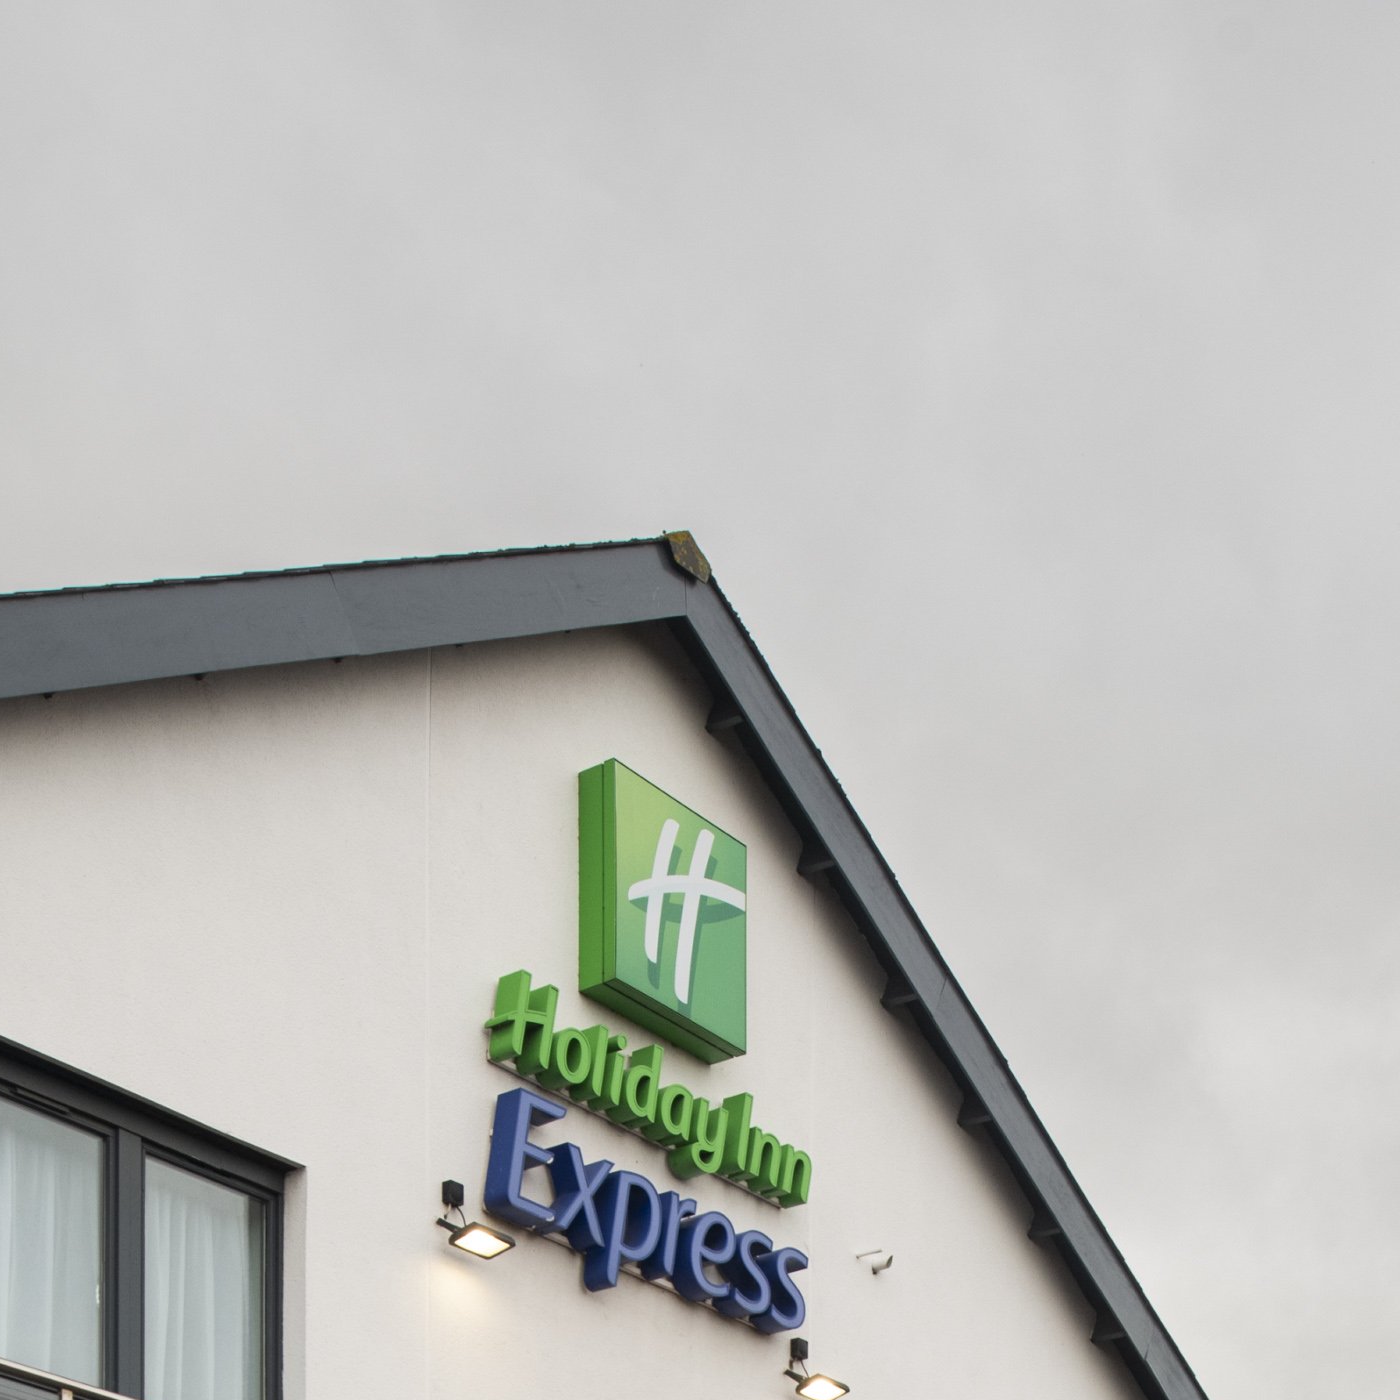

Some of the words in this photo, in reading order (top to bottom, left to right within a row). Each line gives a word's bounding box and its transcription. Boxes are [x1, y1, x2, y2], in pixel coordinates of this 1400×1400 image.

[486, 970, 728, 1180] Holiday
[718, 1092, 812, 1207] Inn
[483, 1087, 809, 1334] Express
